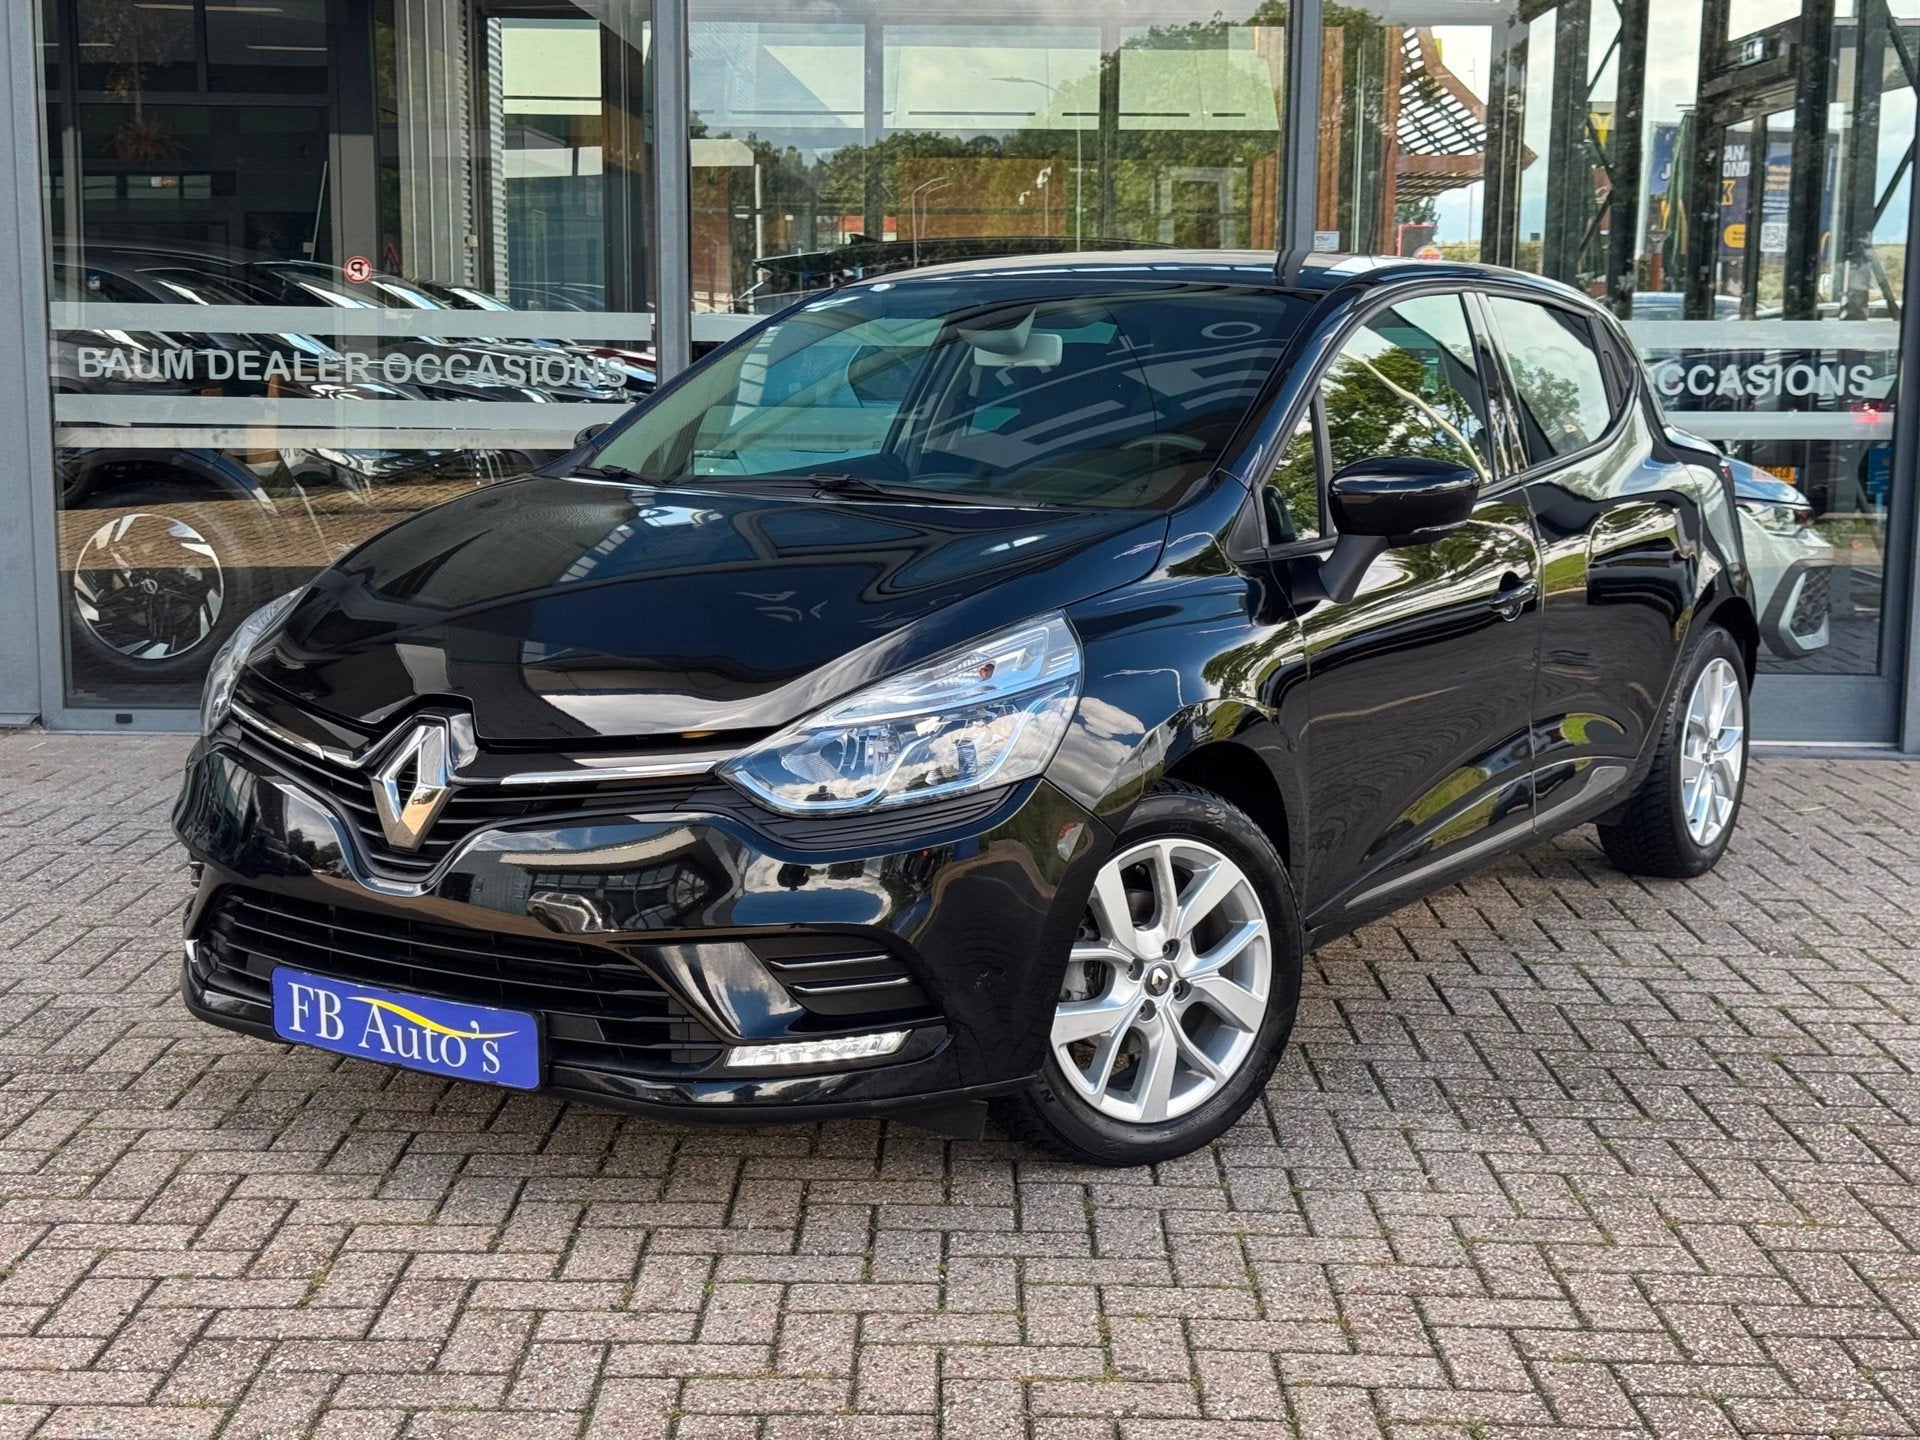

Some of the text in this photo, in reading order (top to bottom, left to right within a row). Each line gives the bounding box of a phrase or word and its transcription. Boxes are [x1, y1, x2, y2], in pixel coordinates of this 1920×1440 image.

[78, 347, 628, 388] BAUM DEALER OCCASIONS
[1651, 364, 1874, 396] CCASIONS
[287, 981, 501, 1074] FB Auto's
